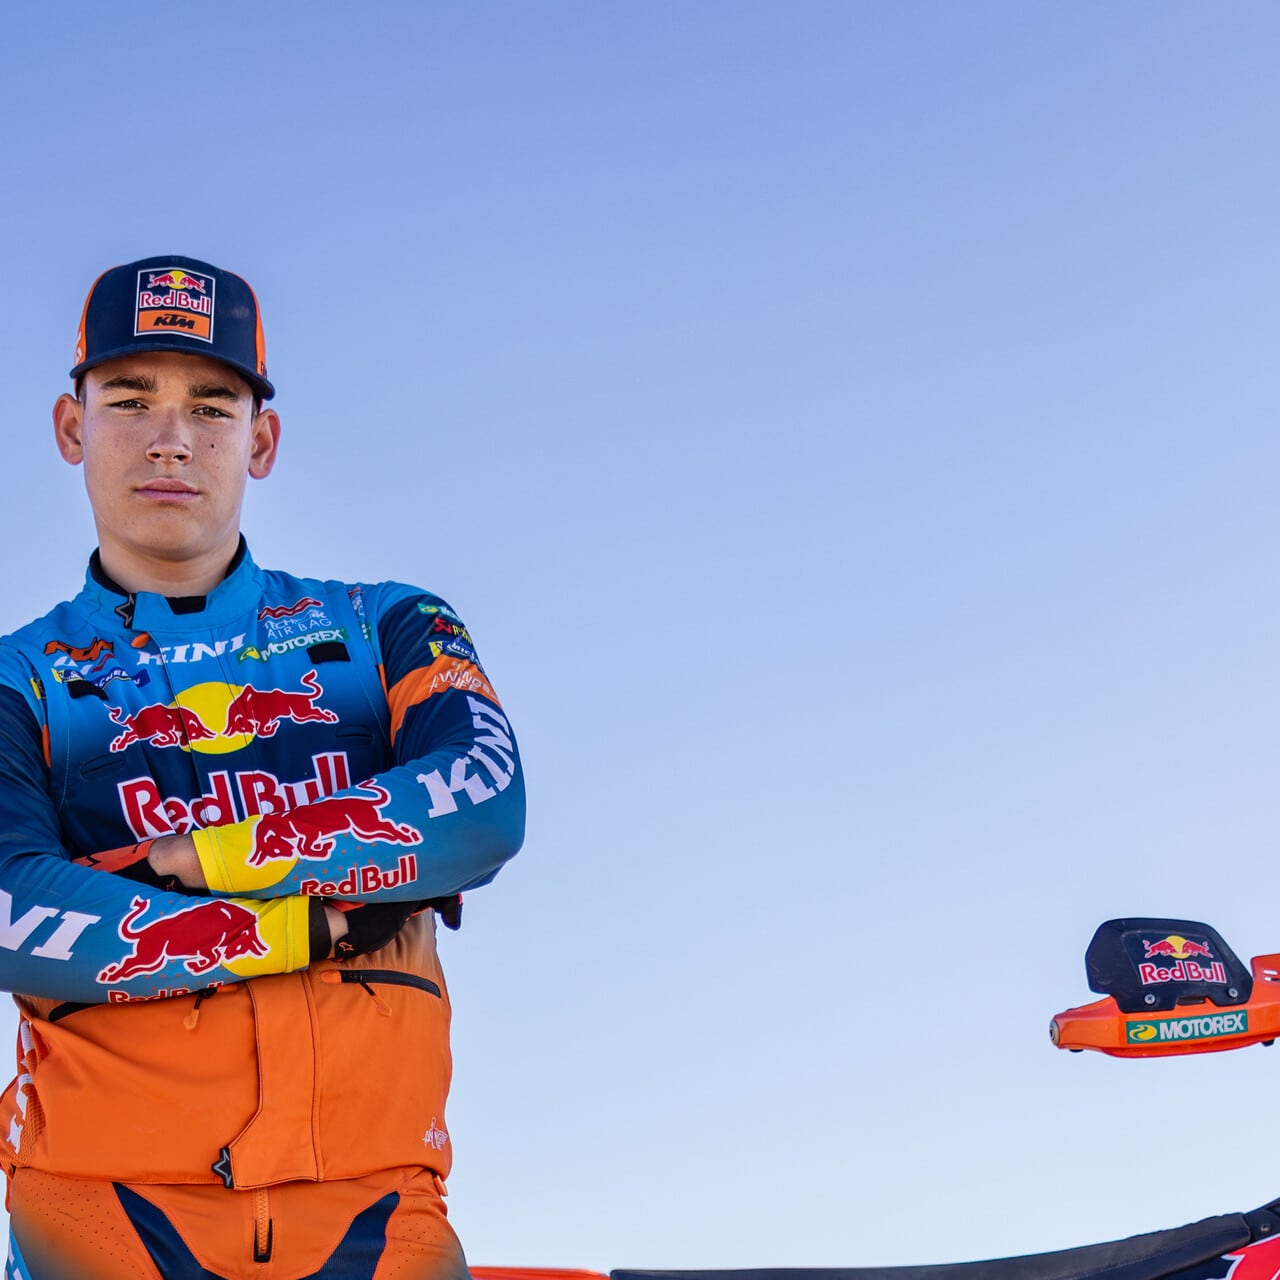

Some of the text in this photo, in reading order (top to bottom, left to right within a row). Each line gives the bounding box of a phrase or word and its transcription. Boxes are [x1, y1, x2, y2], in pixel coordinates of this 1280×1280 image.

[139, 289, 211, 314] Red Bull
[153, 313, 195, 330] KTM
[268, 618, 332, 640] AIR BAG
[136, 632, 247, 666] KINI
[261, 629, 344, 662] MOTOREX
[417, 696, 515, 818] KINI
[119, 752, 352, 839] Red Bull
[301, 854, 418, 896] Red Bull
[1138, 960, 1228, 985] Red Bull
[1160, 1014, 1244, 1041] MOTOREX
